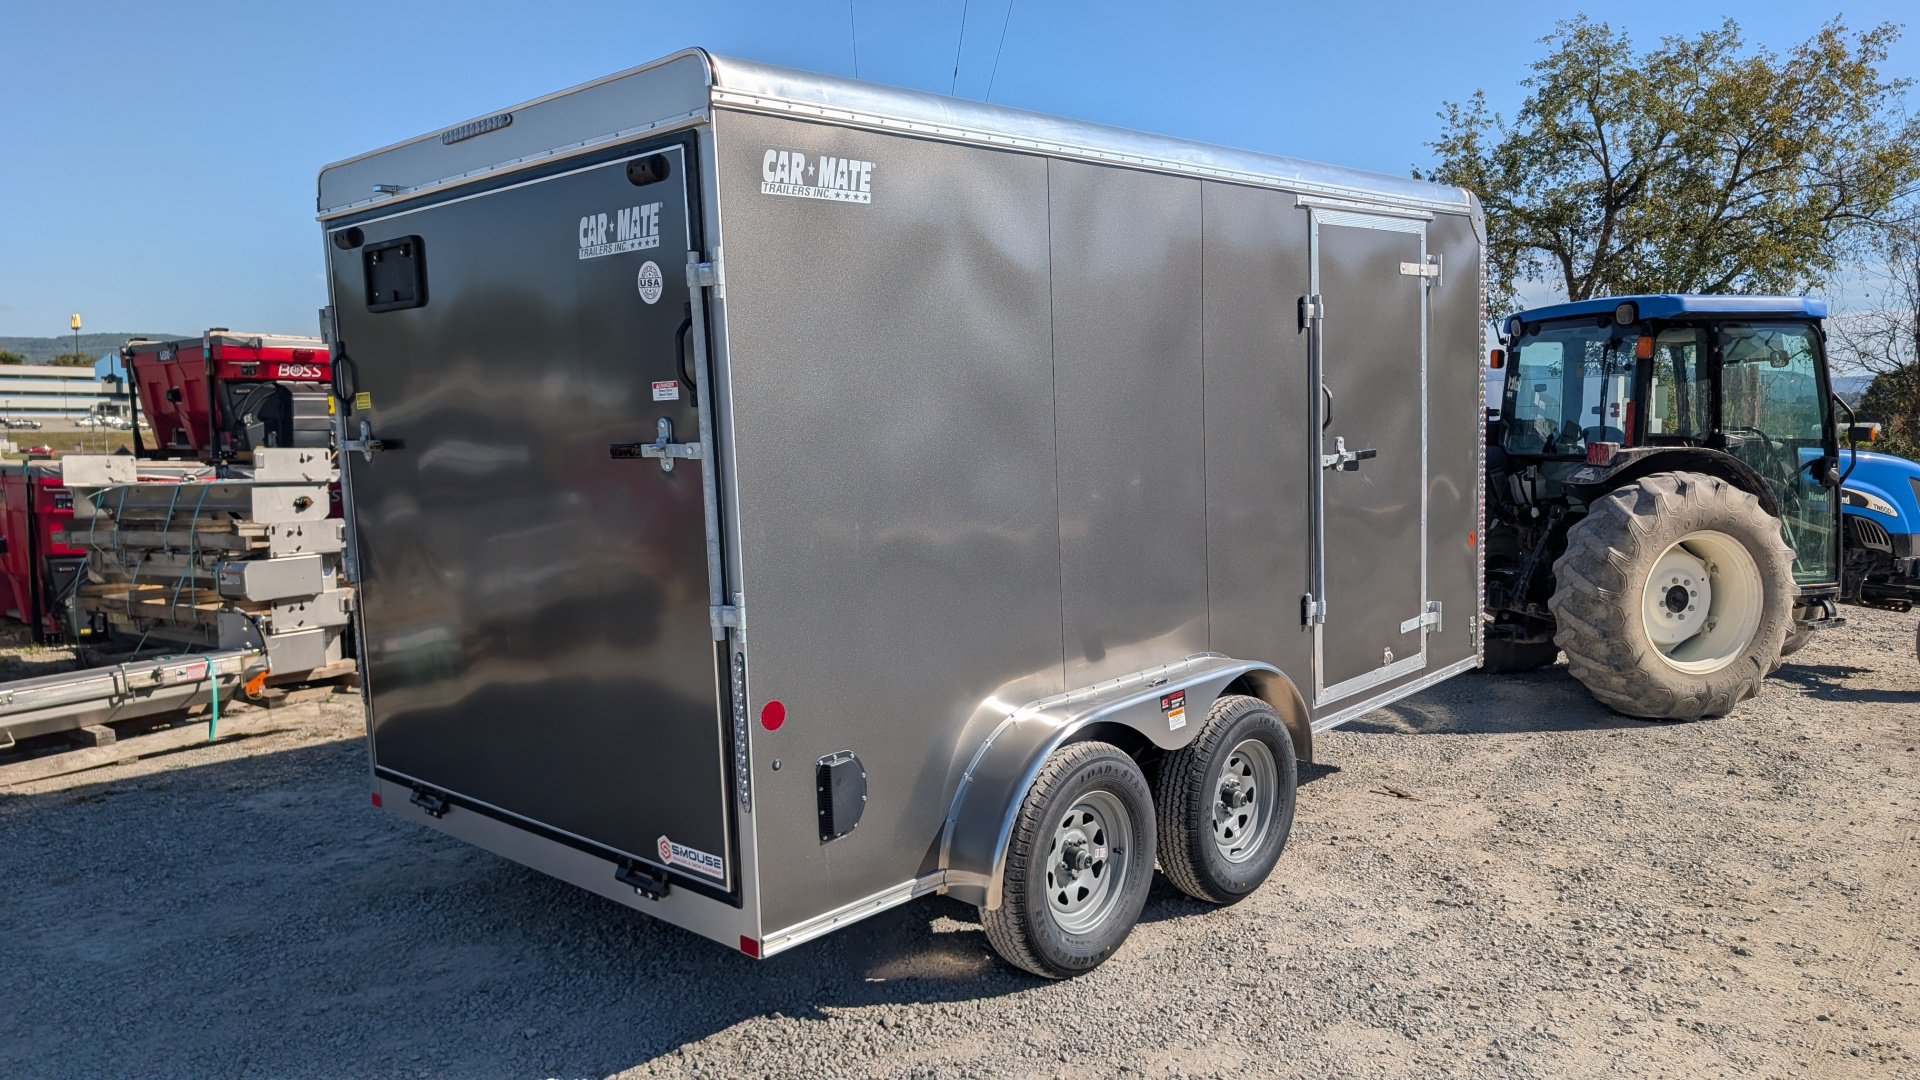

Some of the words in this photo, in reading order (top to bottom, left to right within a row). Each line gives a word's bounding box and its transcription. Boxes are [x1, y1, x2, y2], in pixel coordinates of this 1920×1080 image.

[763, 149, 806, 185] CAR
[818, 155, 872, 192] MATE
[763, 182, 811, 197] TRAILERS
[813, 188, 832, 199] INC.
[579, 213, 608, 248] CAR
[617, 202, 659, 242] MATE
[580, 244, 613, 258] TRAILERS
[614, 242, 629, 253] INC.
[640, 279, 660, 287] USA
[278, 363, 322, 378] BOSS
[1080, 765, 1112, 785] LOAD
[1121, 769, 1145, 798] STAR
[671, 845, 722, 869] SMOUSE
